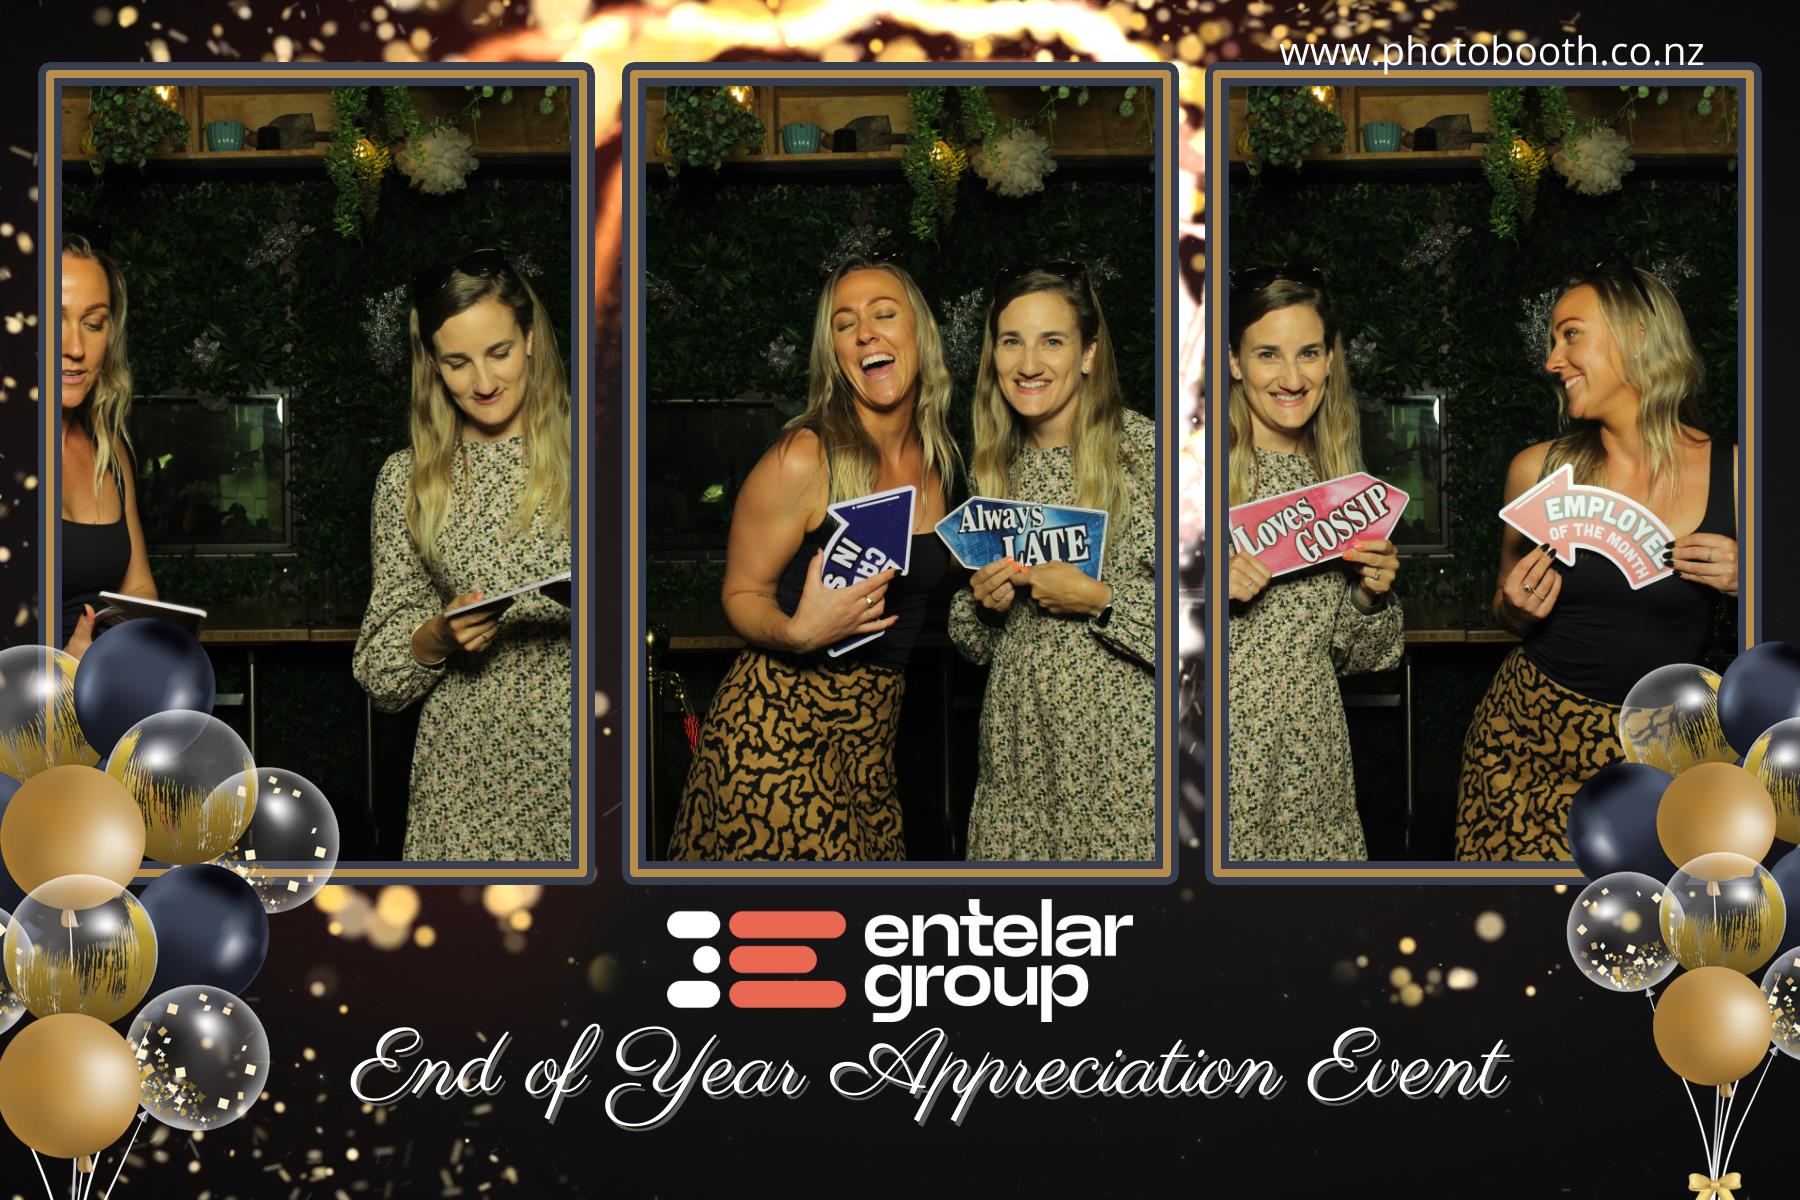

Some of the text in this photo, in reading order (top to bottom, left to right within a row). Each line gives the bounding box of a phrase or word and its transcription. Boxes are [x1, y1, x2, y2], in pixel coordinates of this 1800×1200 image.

[959, 504, 1045, 534] Always
[1232, 497, 1316, 557] Loves
[1295, 483, 1391, 563] GOSSIP
[831, 537, 863, 569] IN
[1003, 525, 1090, 567] LATE
[1549, 523, 1650, 580] OF THE MONTH
